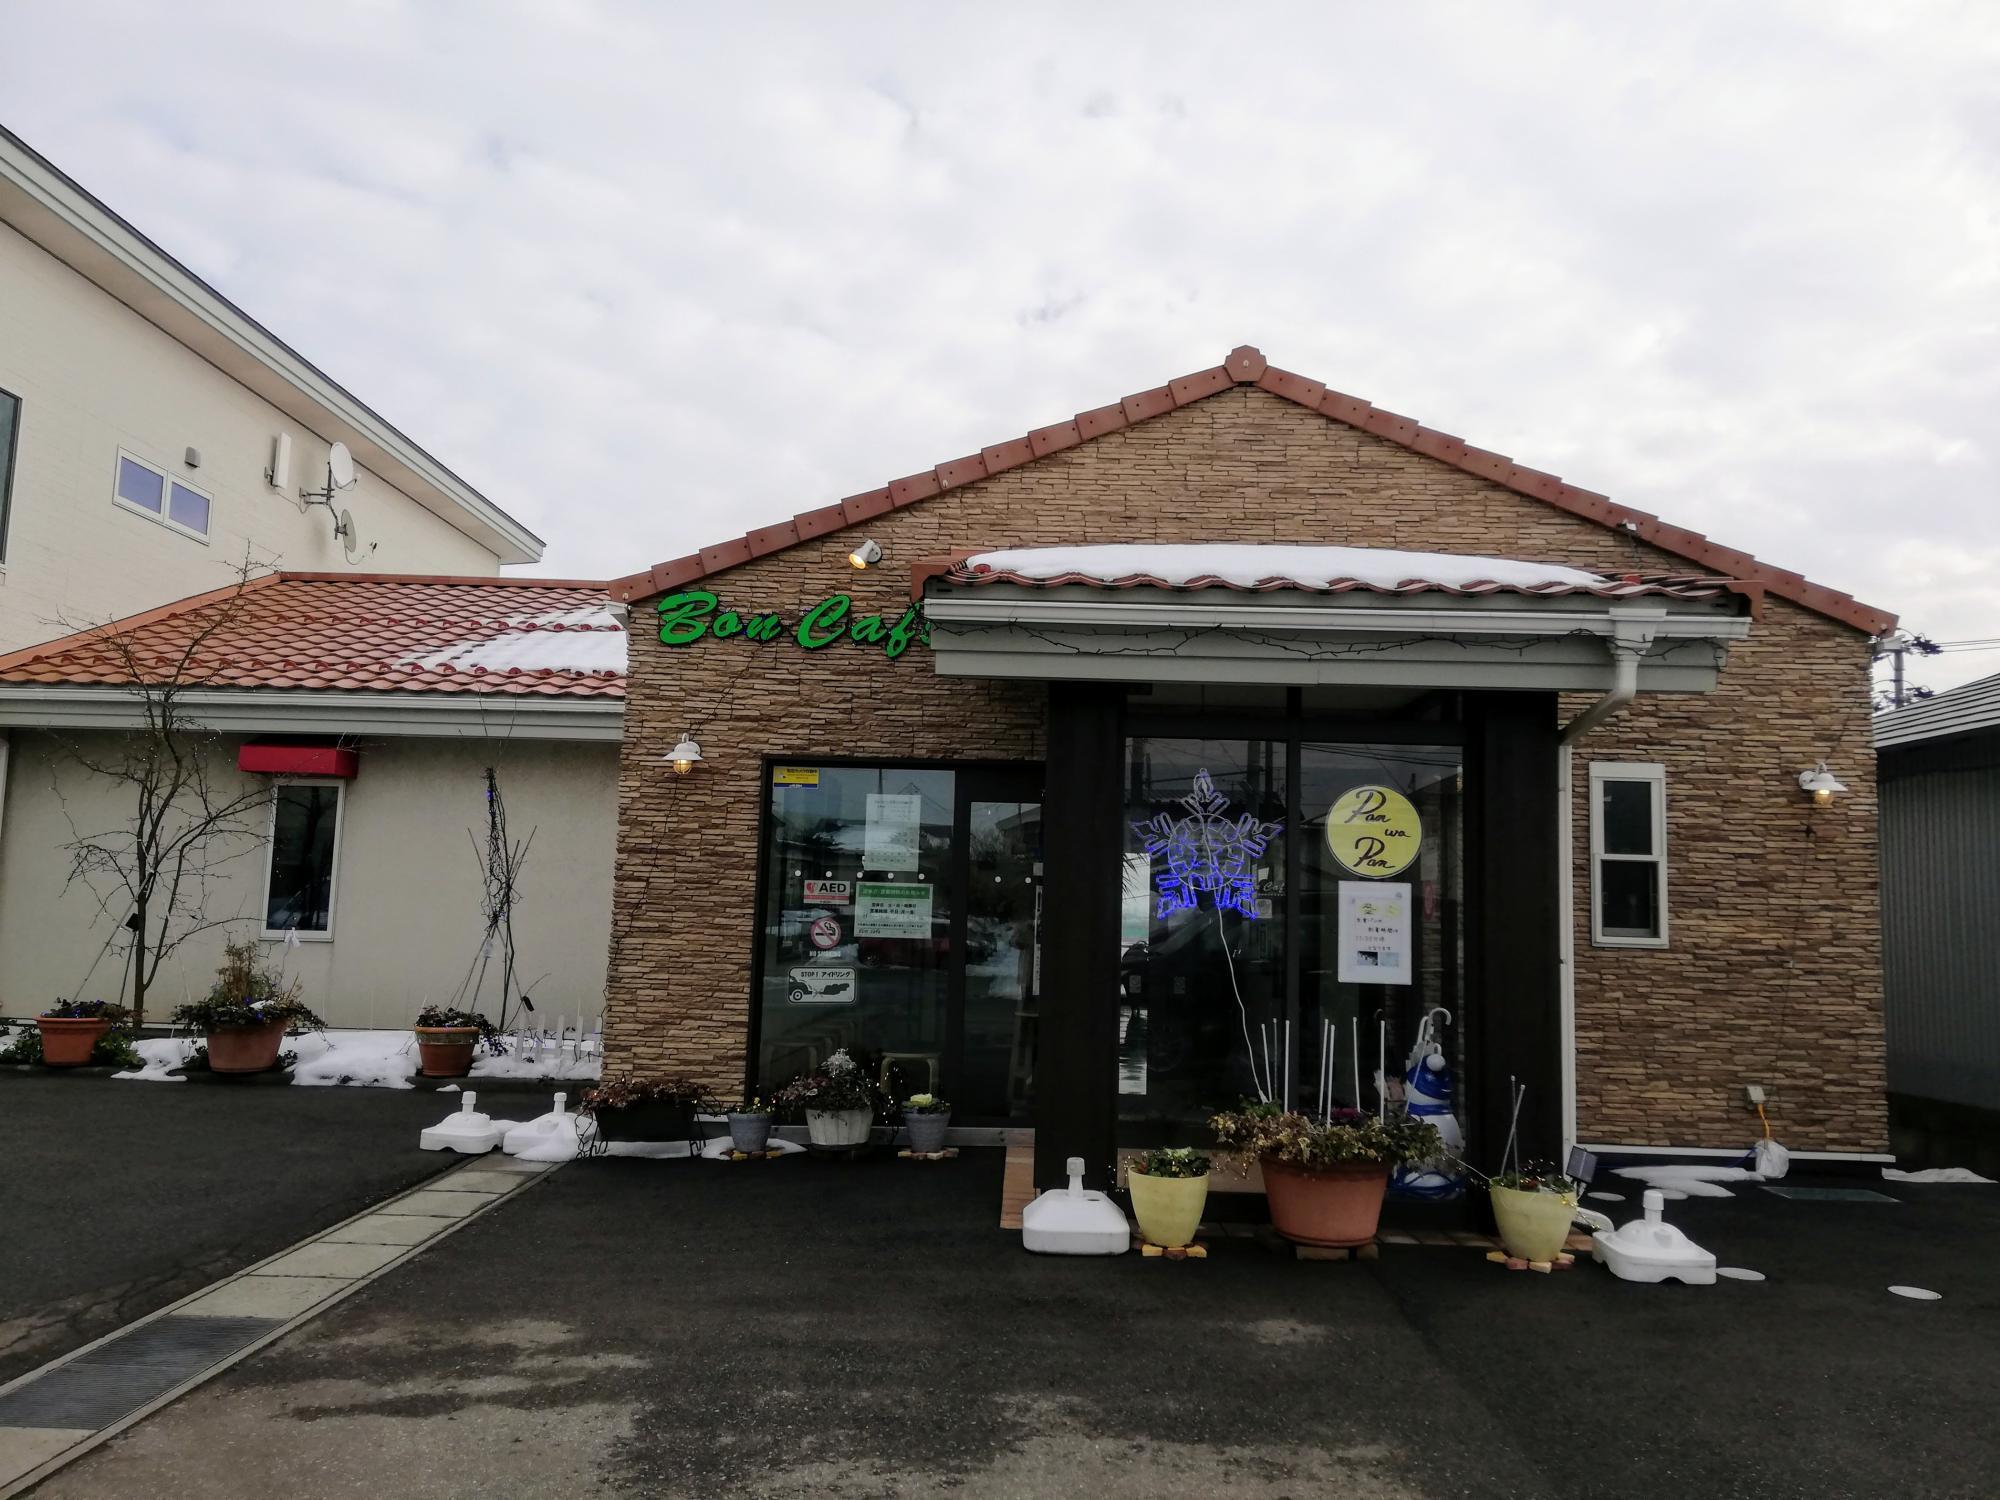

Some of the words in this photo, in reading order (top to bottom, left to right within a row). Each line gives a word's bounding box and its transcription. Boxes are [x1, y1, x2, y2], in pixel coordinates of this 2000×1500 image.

[658, 591, 781, 645] Bon
[1344, 789, 1391, 823] Pan
[1384, 828, 1411, 838] wa
[1353, 836, 1395, 868] Pan
[819, 882, 847, 893] AED
